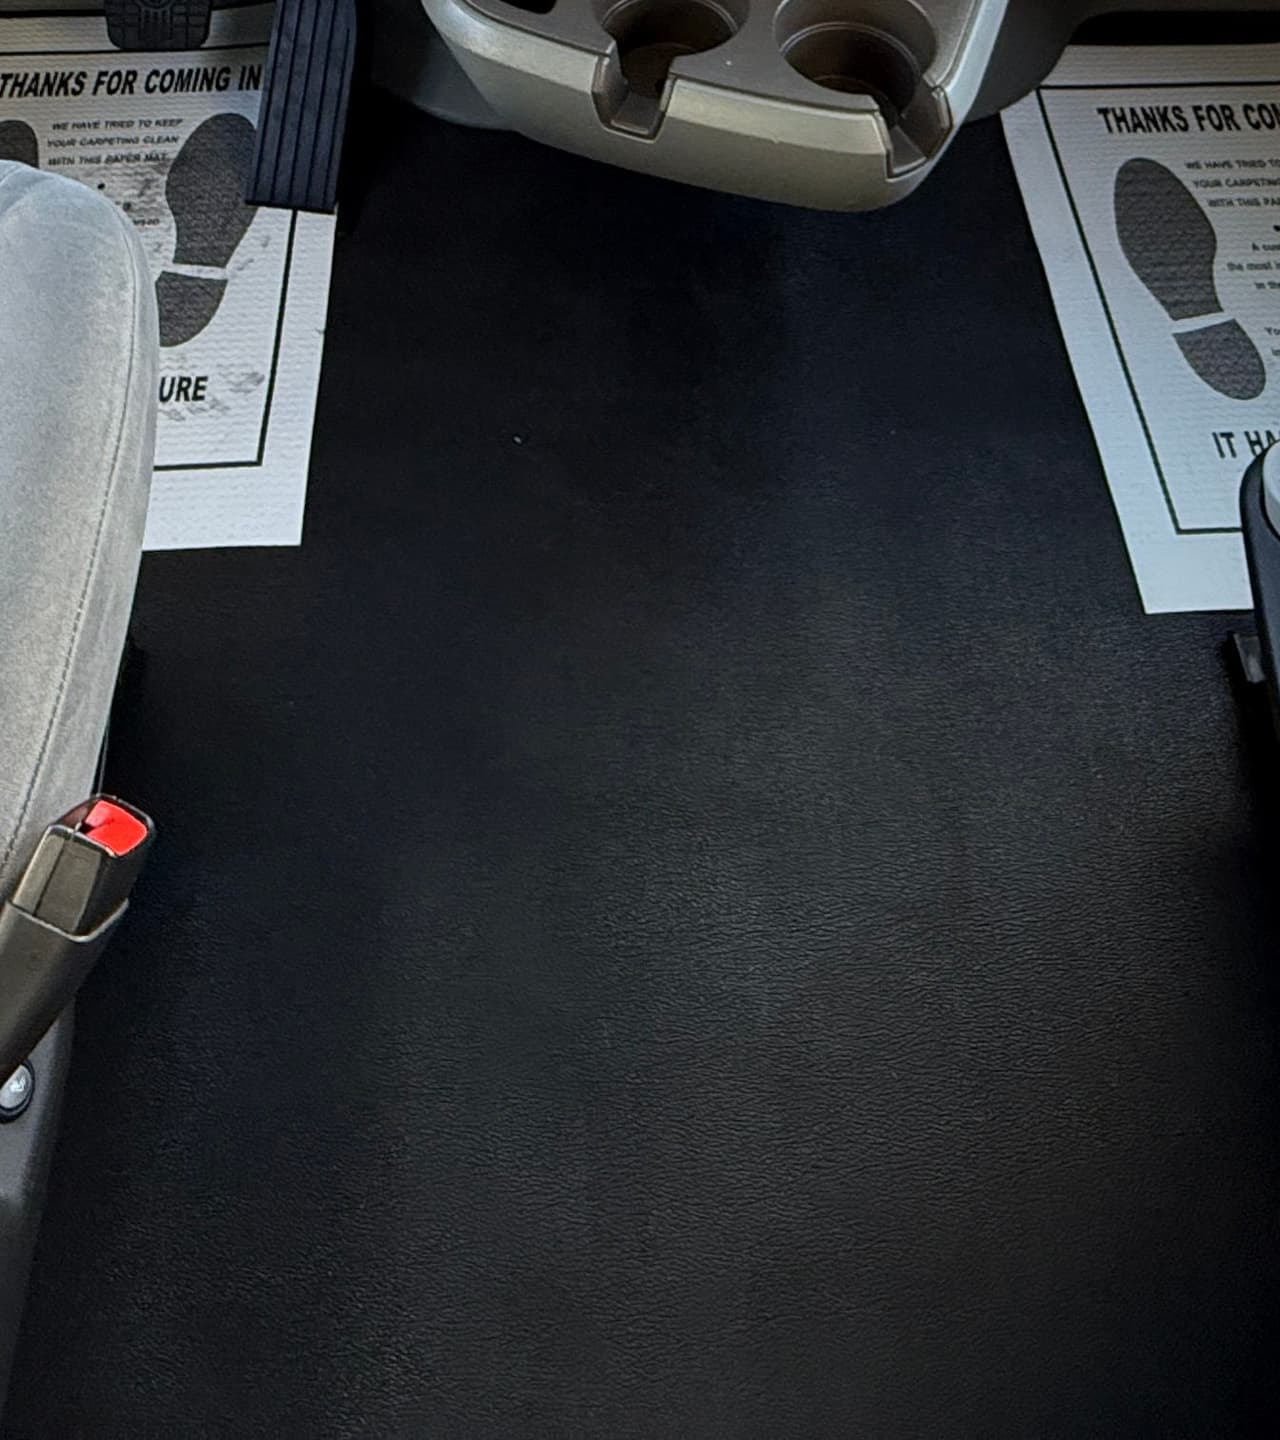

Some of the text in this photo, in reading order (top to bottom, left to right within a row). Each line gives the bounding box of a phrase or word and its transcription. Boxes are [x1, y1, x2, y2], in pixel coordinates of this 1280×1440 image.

[92, 70, 137, 96] FOR
[144, 66, 231, 94] COMING
[237, 64, 261, 91] IN
[52, 118, 183, 131] WE HAVE TRIED TO KEEP
[1097, 104, 1189, 134] THANKS
[1191, 103, 1241, 131] FOR
[48, 135, 180, 148] YOUR CARPETING CLEAN
[48, 152, 168, 165] WITH THIS PAPER MAT
[1185, 161, 1203, 169] WE
[1205, 160, 1234, 169] HAVE
[1236, 160, 1266, 169] TRIED
[1192, 179, 1223, 189] YOUR
[1207, 198, 1233, 207] WITH
[1235, 197, 1260, 207] THIS
[1252, 242, 1260, 251] A
[1227, 263, 1243, 271] the
[1246, 261, 1271, 271] most
[1212, 431, 1237, 459] IT
